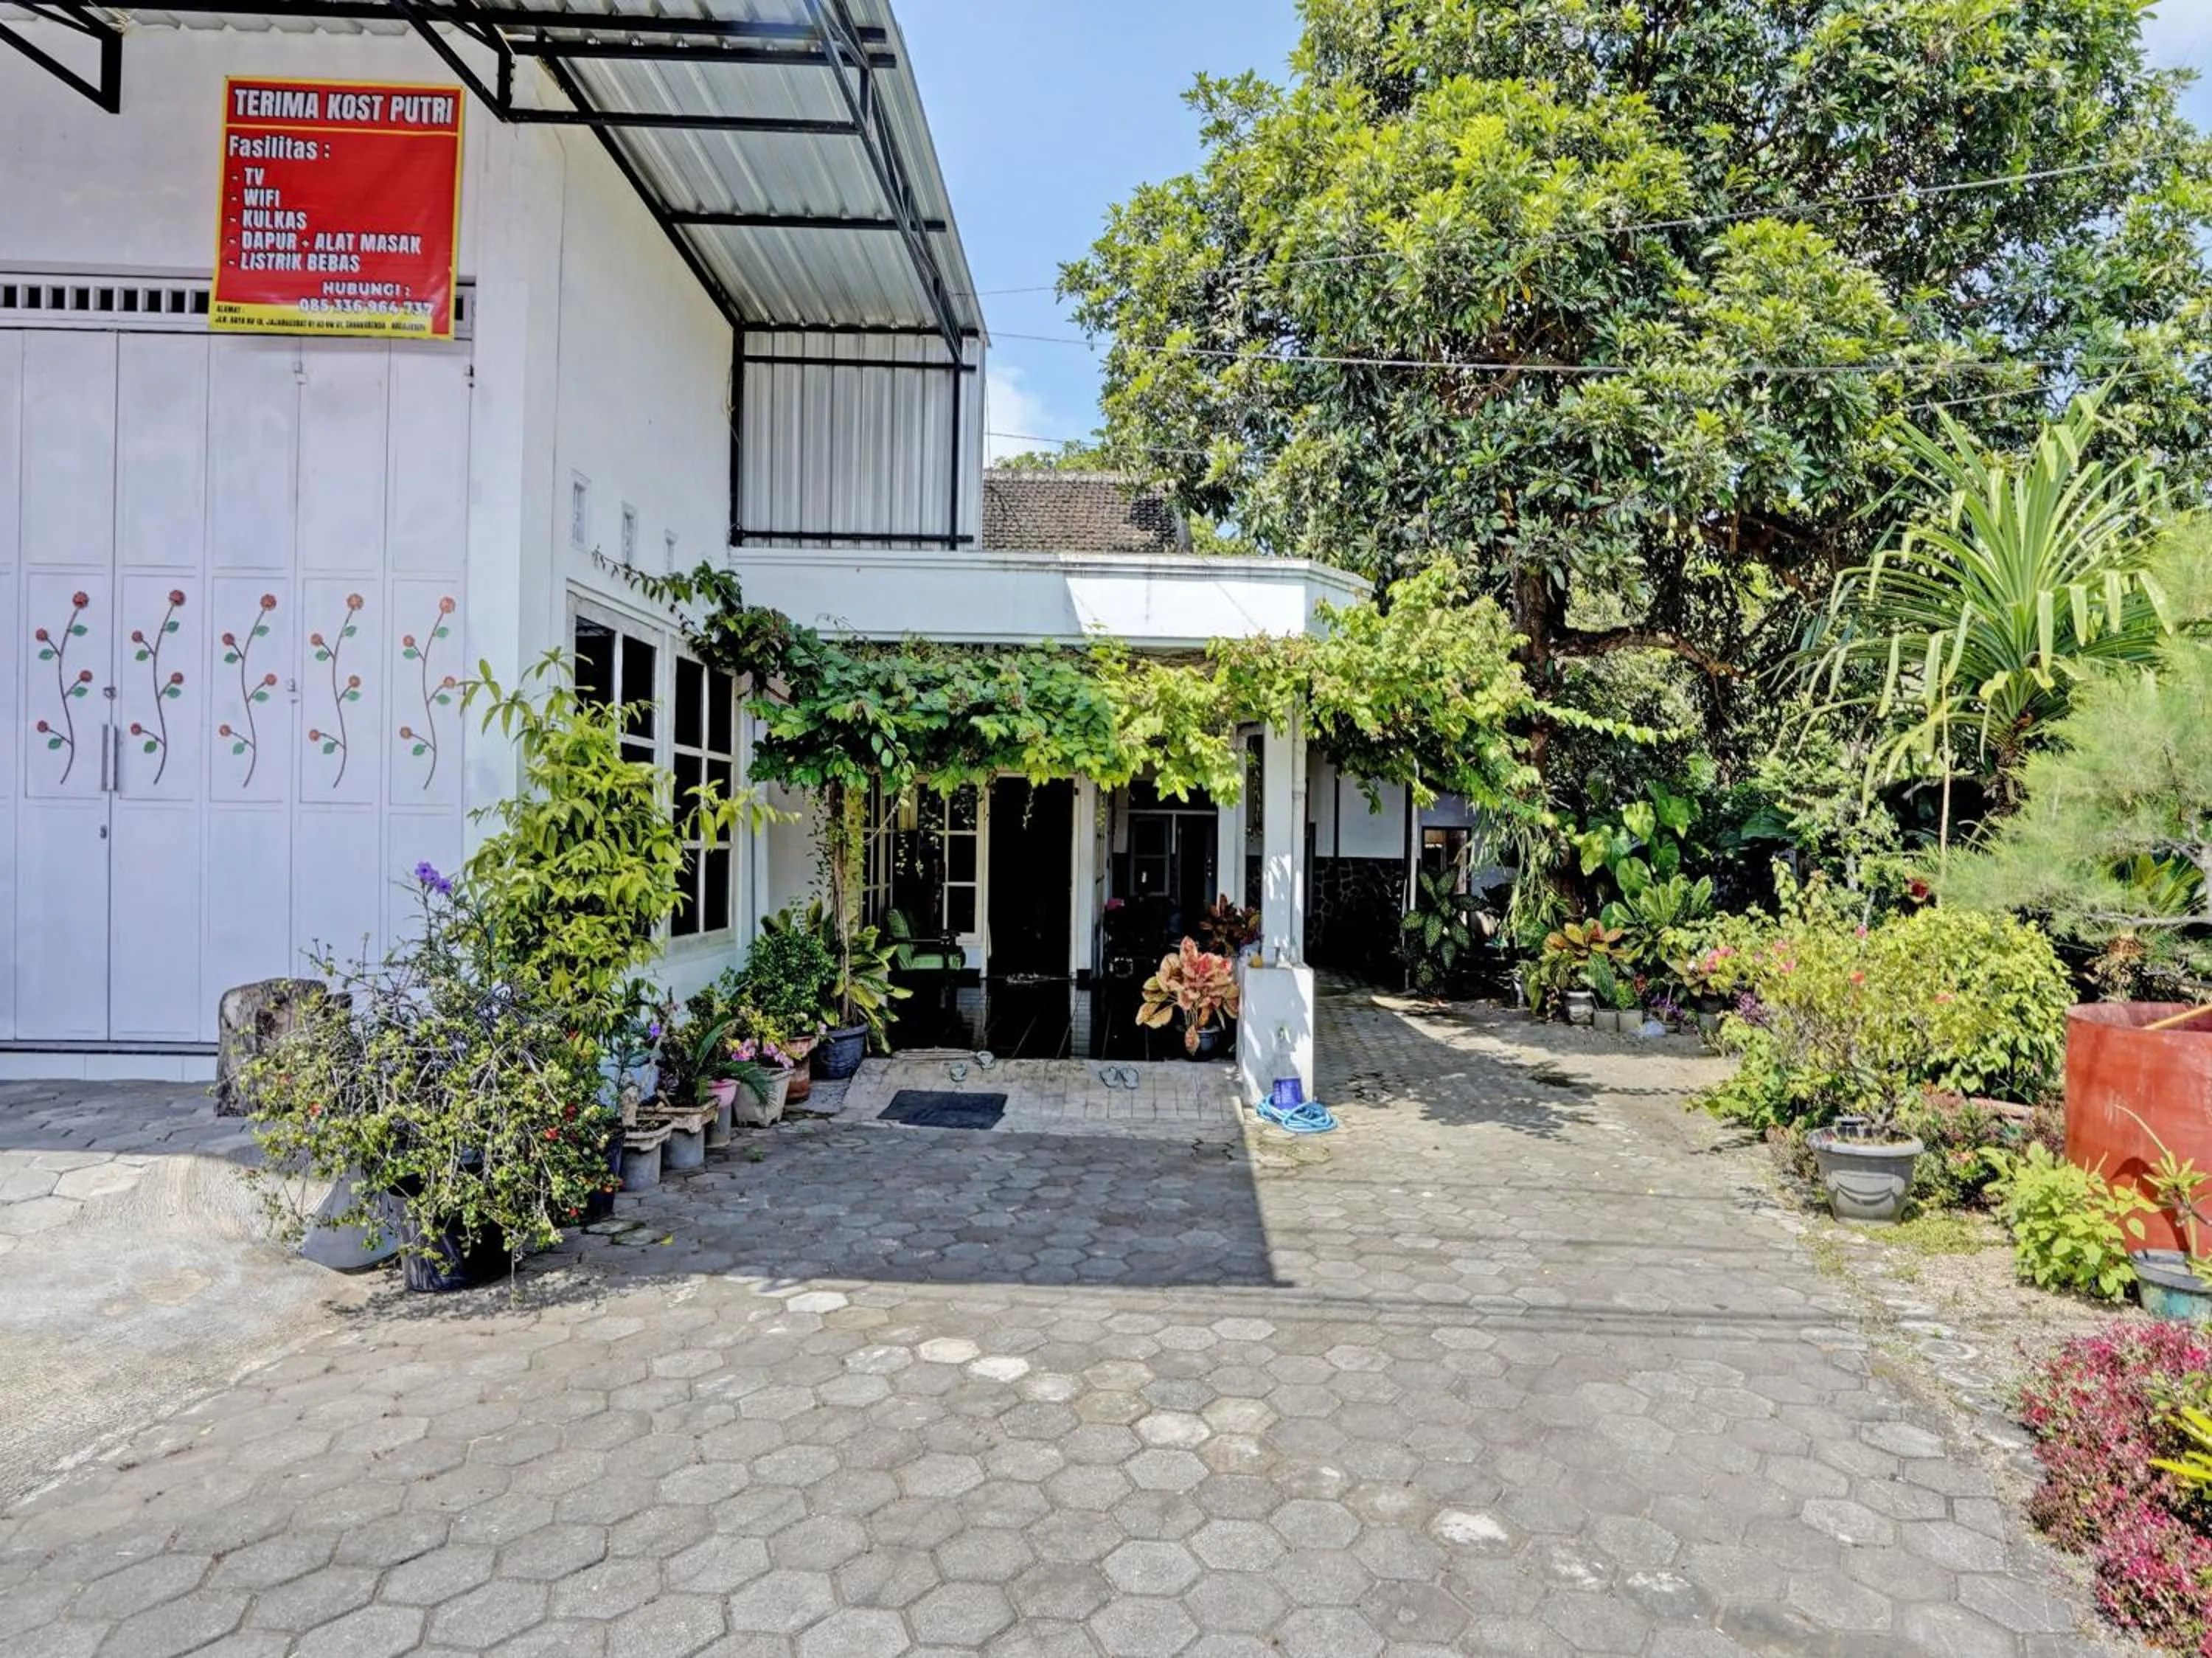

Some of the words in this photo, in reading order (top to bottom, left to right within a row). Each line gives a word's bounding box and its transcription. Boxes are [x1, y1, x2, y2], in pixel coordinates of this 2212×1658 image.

[234, 88, 319, 119] TERIMA
[327, 93, 383, 122] KOST
[389, 95, 453, 125] PUTRI
[229, 135, 318, 160] Fasilitas
[244, 167, 265, 186] TV
[243, 187, 280, 207] WIFI
[242, 209, 307, 231] KULKAS
[241, 231, 296, 251] DAPUR
[314, 233, 355, 252] ALAT
[360, 234, 422, 254] MASAK
[240, 252, 302, 271] LISTRIK
[307, 254, 361, 273] BEBAS
[322, 282, 401, 296] HUBUNGI
[299, 297, 329, 312] 085
[333, 298, 363, 313] 336
